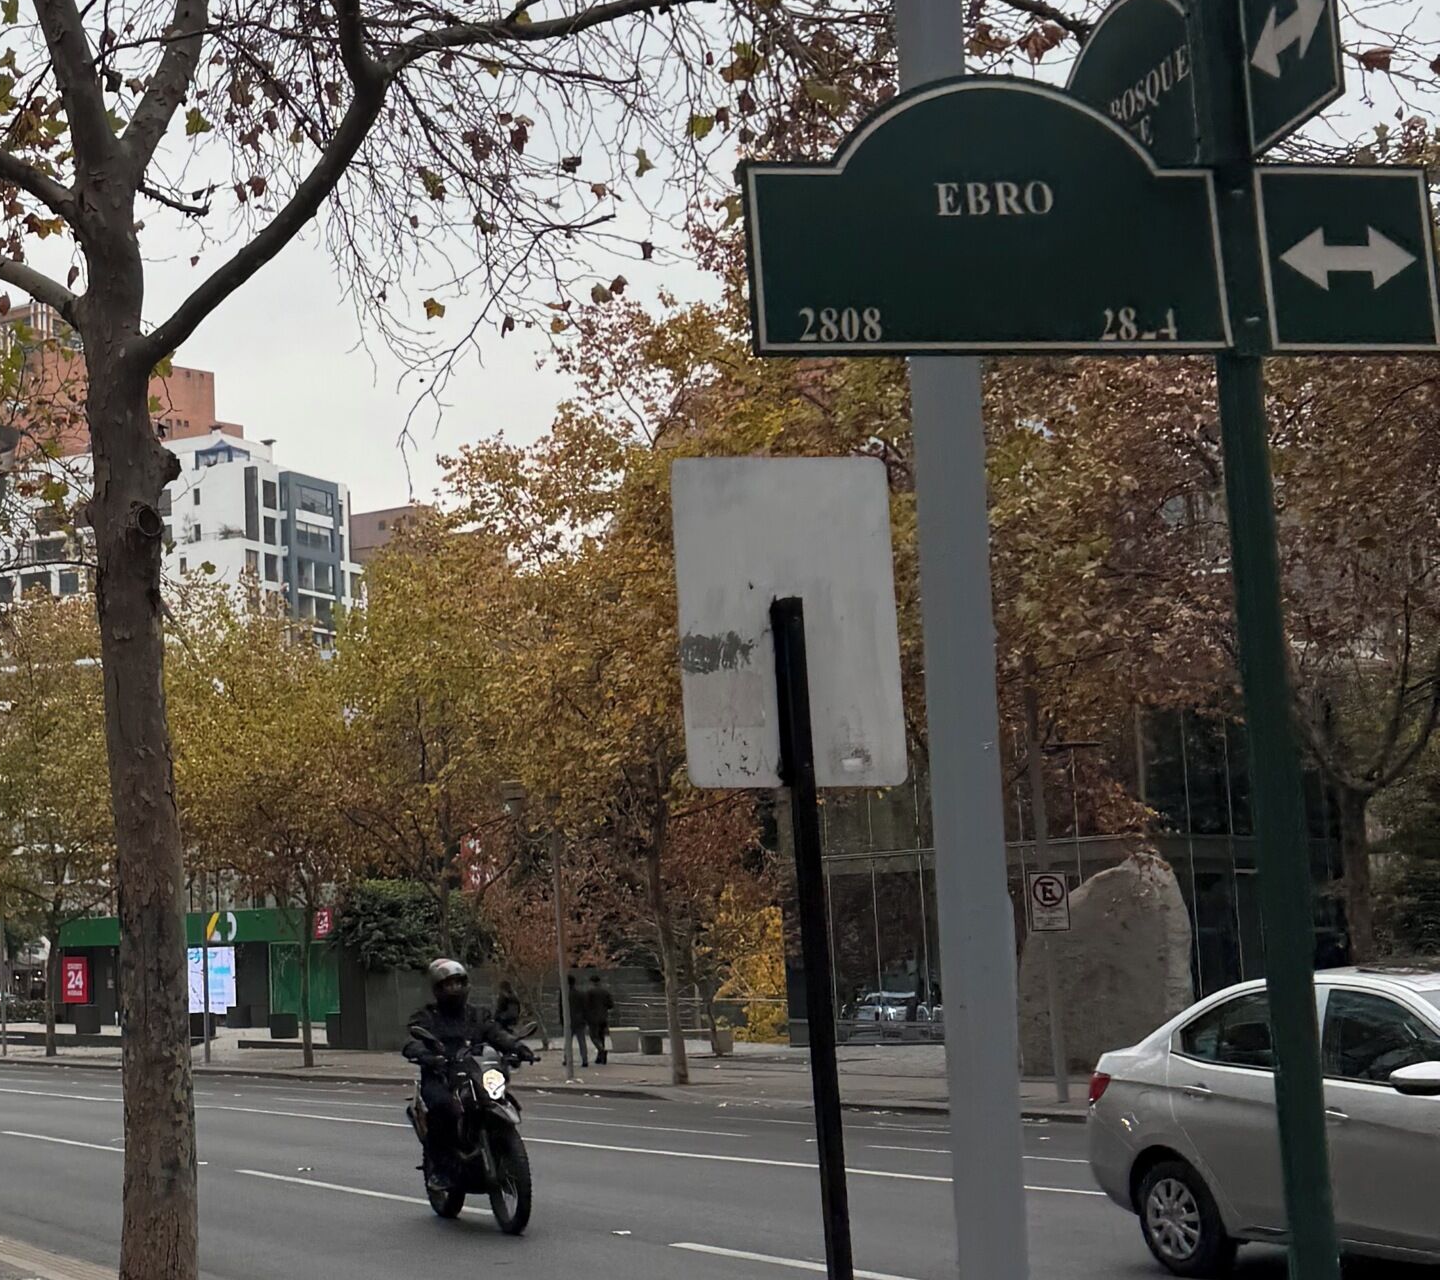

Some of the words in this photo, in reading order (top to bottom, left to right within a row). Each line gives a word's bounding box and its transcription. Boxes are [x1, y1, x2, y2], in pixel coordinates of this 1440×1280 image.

[1110, 44, 1190, 121] BOSQUE
[934, 180, 1054, 217] EBRO
[798, 306, 883, 343] 2808
[1100, 306, 1178, 342] 284
[67, 970, 84, 990] 24
